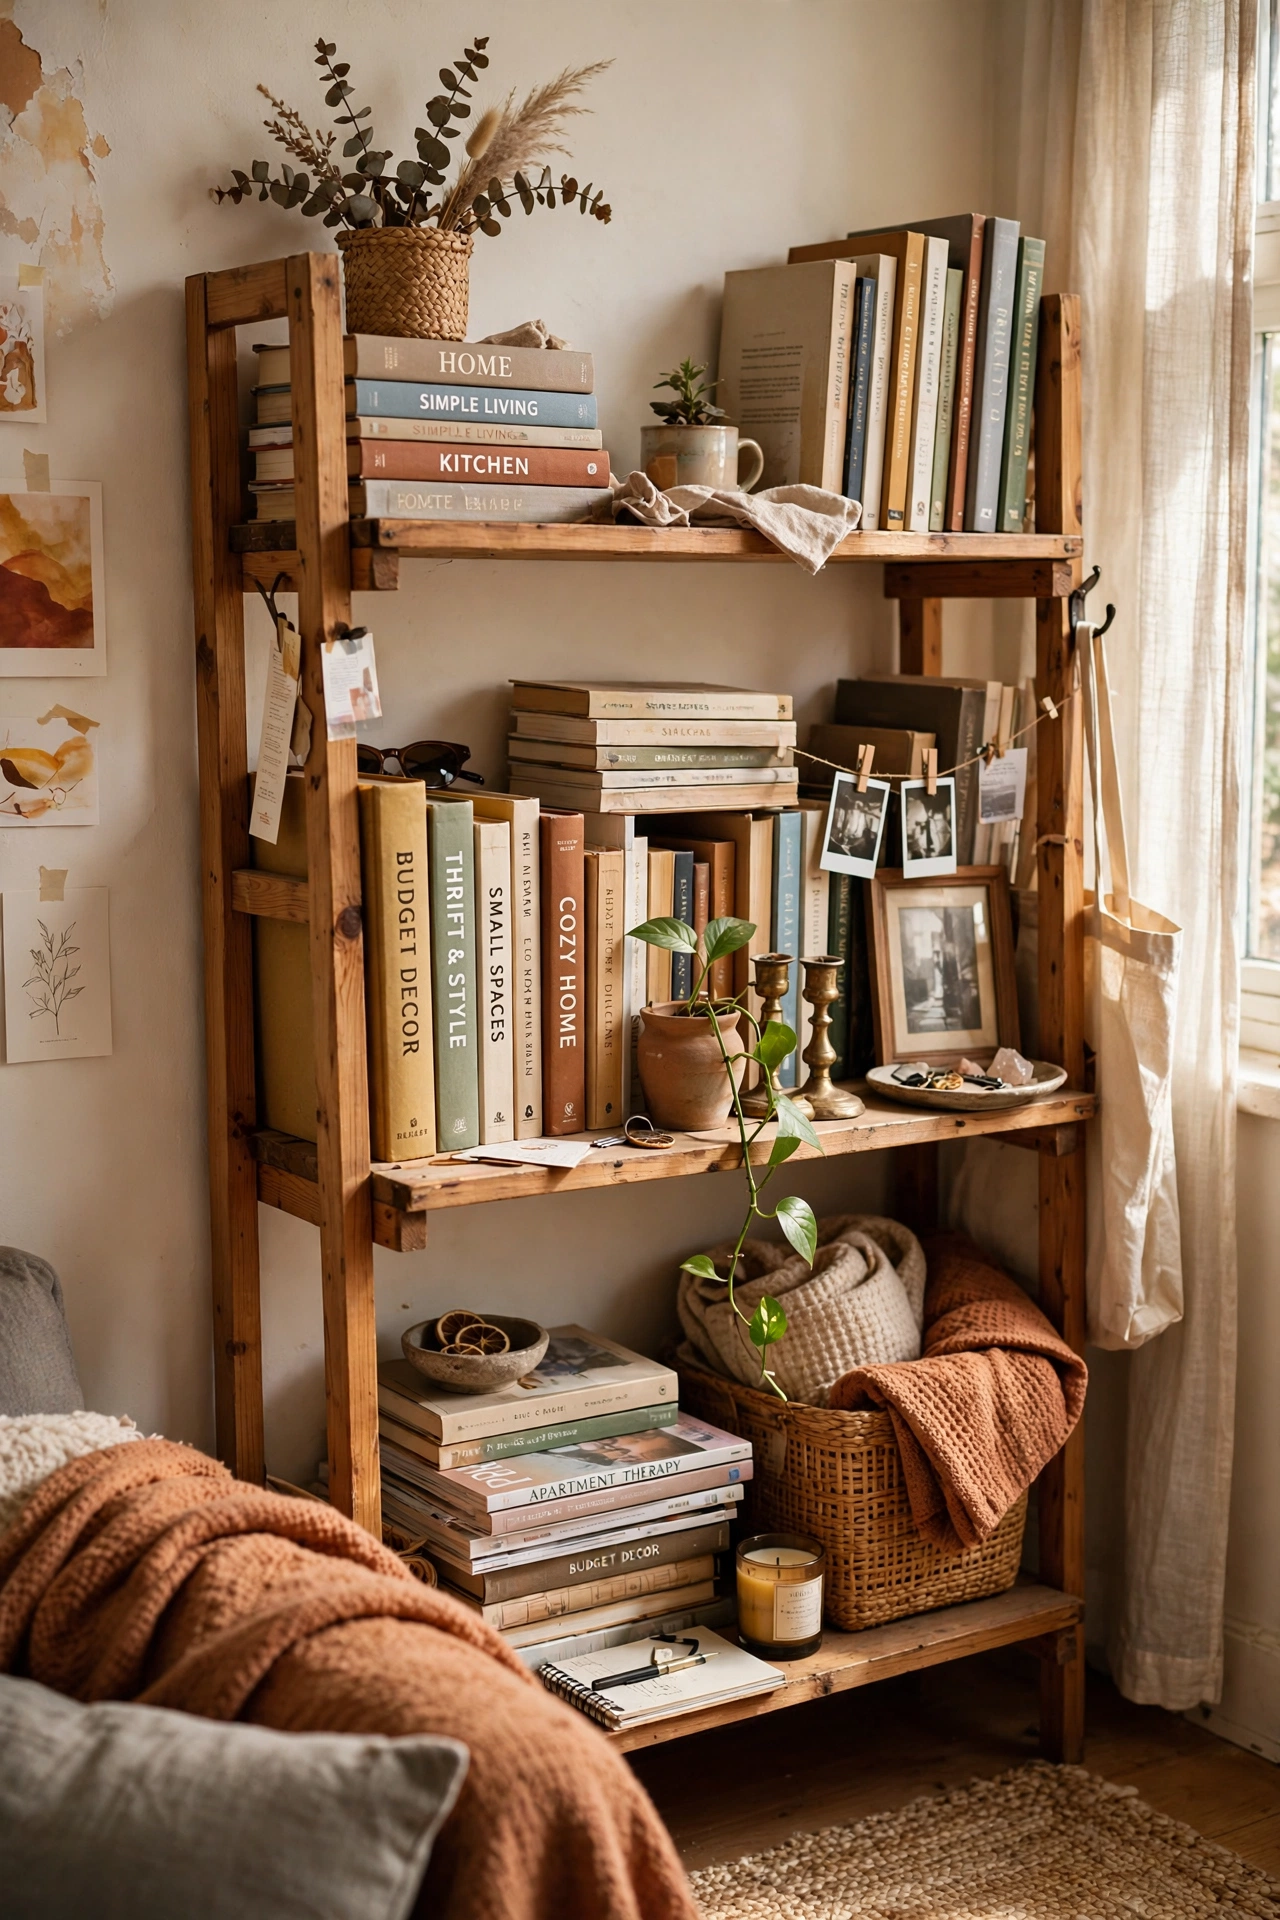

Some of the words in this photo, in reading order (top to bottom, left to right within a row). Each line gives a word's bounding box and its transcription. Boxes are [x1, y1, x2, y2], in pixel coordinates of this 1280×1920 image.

[439, 351, 513, 378] HOME
[419, 393, 479, 413] SIMPLE
[484, 398, 538, 417] LIVING
[476, 429, 517, 441] LIVING
[439, 453, 529, 475] KITCHEN
[396, 851, 417, 956] BUDGET
[445, 851, 465, 940] THRIFT
[489, 887, 503, 957] SMALL
[448, 949, 465, 966] &
[559, 896, 576, 965] COZY
[400, 967, 420, 1057] DECOR
[448, 973, 467, 1049] STYLE
[490, 965, 505, 1043] SPACES
[559, 975, 576, 1049] HOME
[529, 1472, 616, 1502] APARTMENT
[622, 1459, 682, 1483] THERAPY
[569, 1553, 616, 1575] BUDGET
[621, 1543, 660, 1563] DECOR
